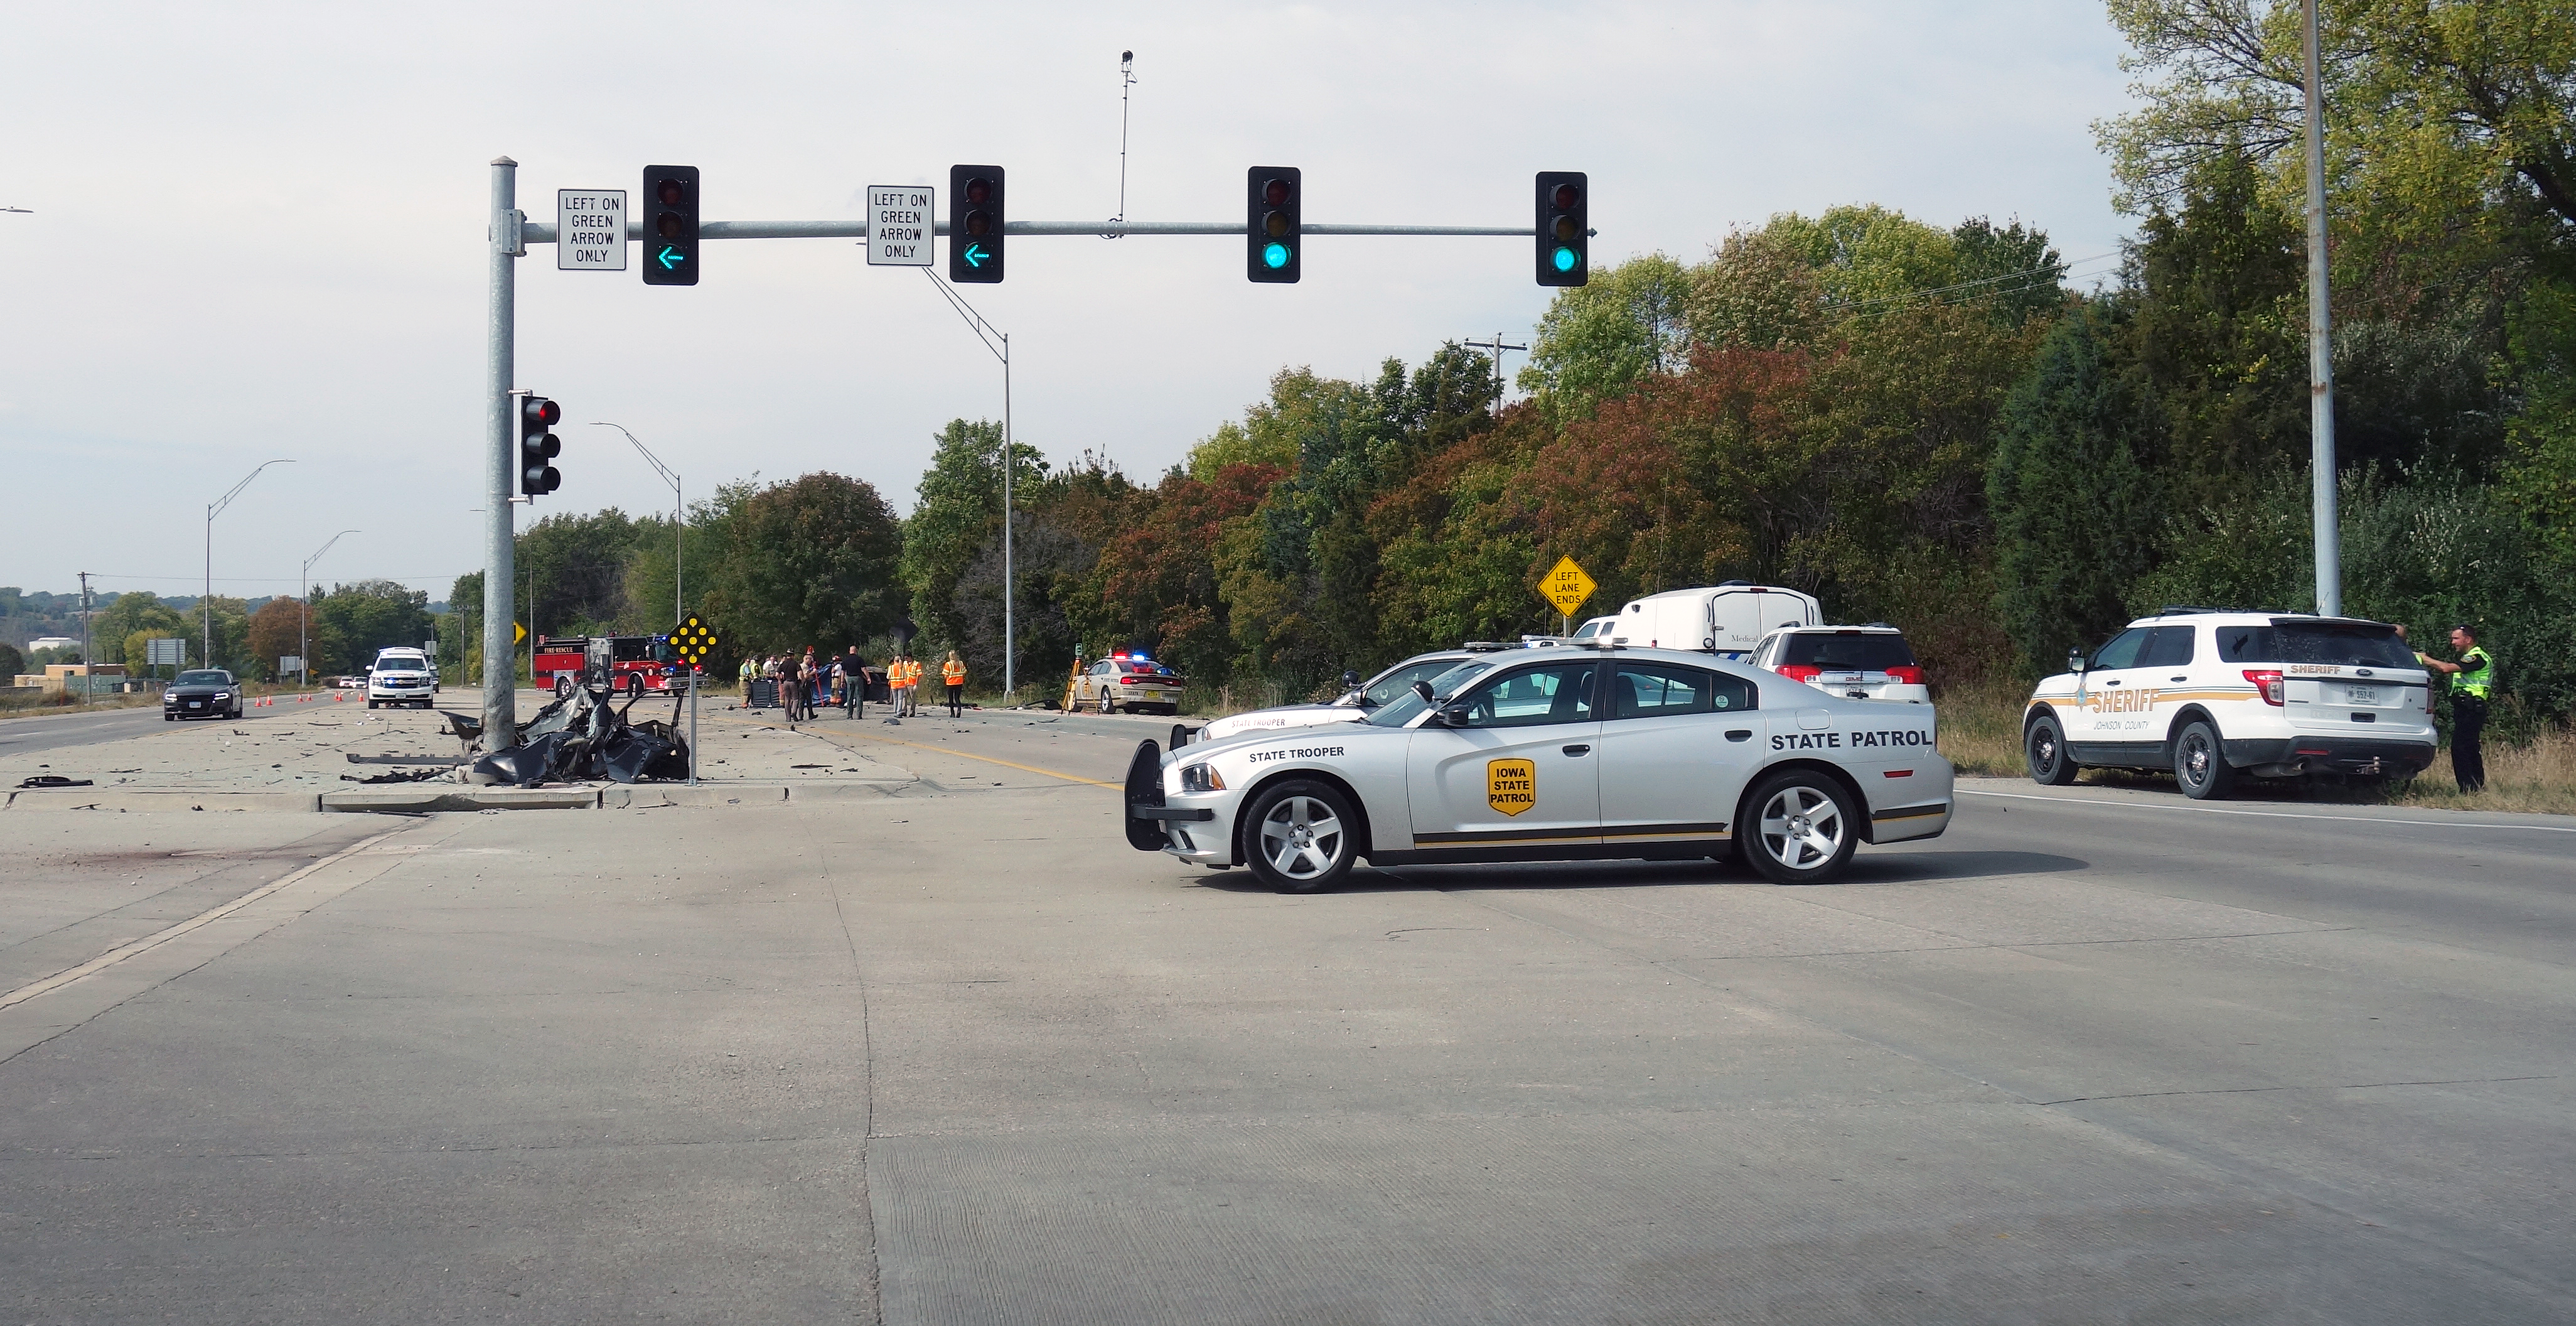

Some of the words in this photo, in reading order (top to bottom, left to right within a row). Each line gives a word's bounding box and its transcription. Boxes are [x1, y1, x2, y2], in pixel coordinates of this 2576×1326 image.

[566, 197, 596, 210] LEFT
[603, 198, 619, 210] ON
[874, 193, 904, 206] LEFT
[911, 194, 926, 207] ON
[572, 215, 613, 227] GREEN
[881, 210, 921, 224] GREEN
[570, 232, 614, 245] ARROW
[879, 228, 922, 240] ARROW
[576, 249, 608, 262] ONLY
[885, 245, 916, 258] ONLY
[1556, 572, 1579, 581] LEFT
[1555, 583, 1580, 592] LANE
[1556, 595, 1581, 604] ENDS
[2290, 665, 2341, 674] SHERIFF
[2093, 689, 2160, 713] SHERIFF
[2093, 721, 2122, 730] JOHNSON
[2125, 721, 2150, 730] COUNTY
[1771, 733, 1841, 750] STATE
[1851, 730, 1933, 748] PATROL
[1250, 750, 1286, 763] STATE
[1289, 747, 1344, 758] TROOPER
[1496, 768, 1527, 777] IOWA
[1494, 780, 1530, 790] STATE
[1490, 793, 1533, 803] PATROL
